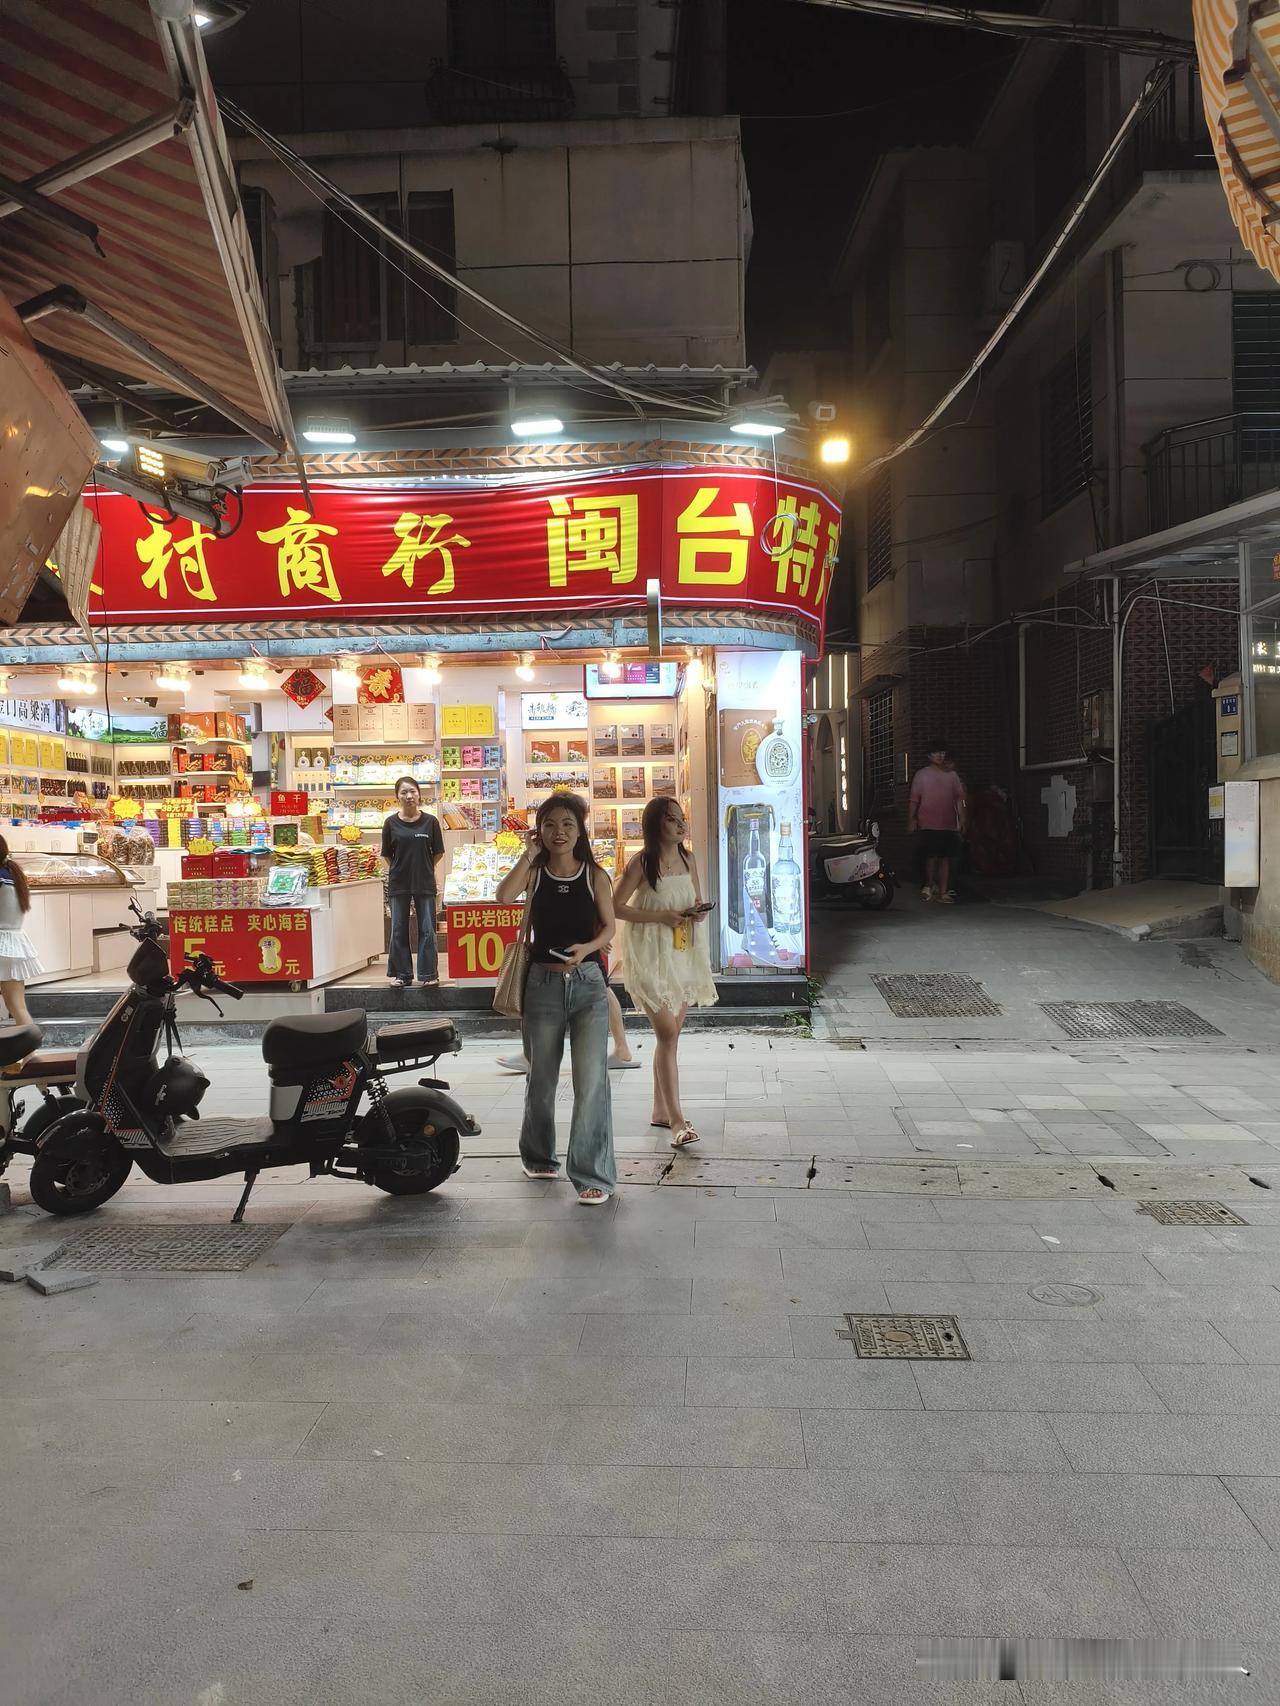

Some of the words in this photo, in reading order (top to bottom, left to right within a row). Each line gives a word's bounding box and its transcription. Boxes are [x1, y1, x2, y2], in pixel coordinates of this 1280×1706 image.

[46, 507, 471, 601] 村商行
[150, 721, 168, 738] 福
[173, 914, 234, 934] 传统糕点
[248, 913, 308, 932] 夹心海苔
[458, 932, 504, 972] 10
